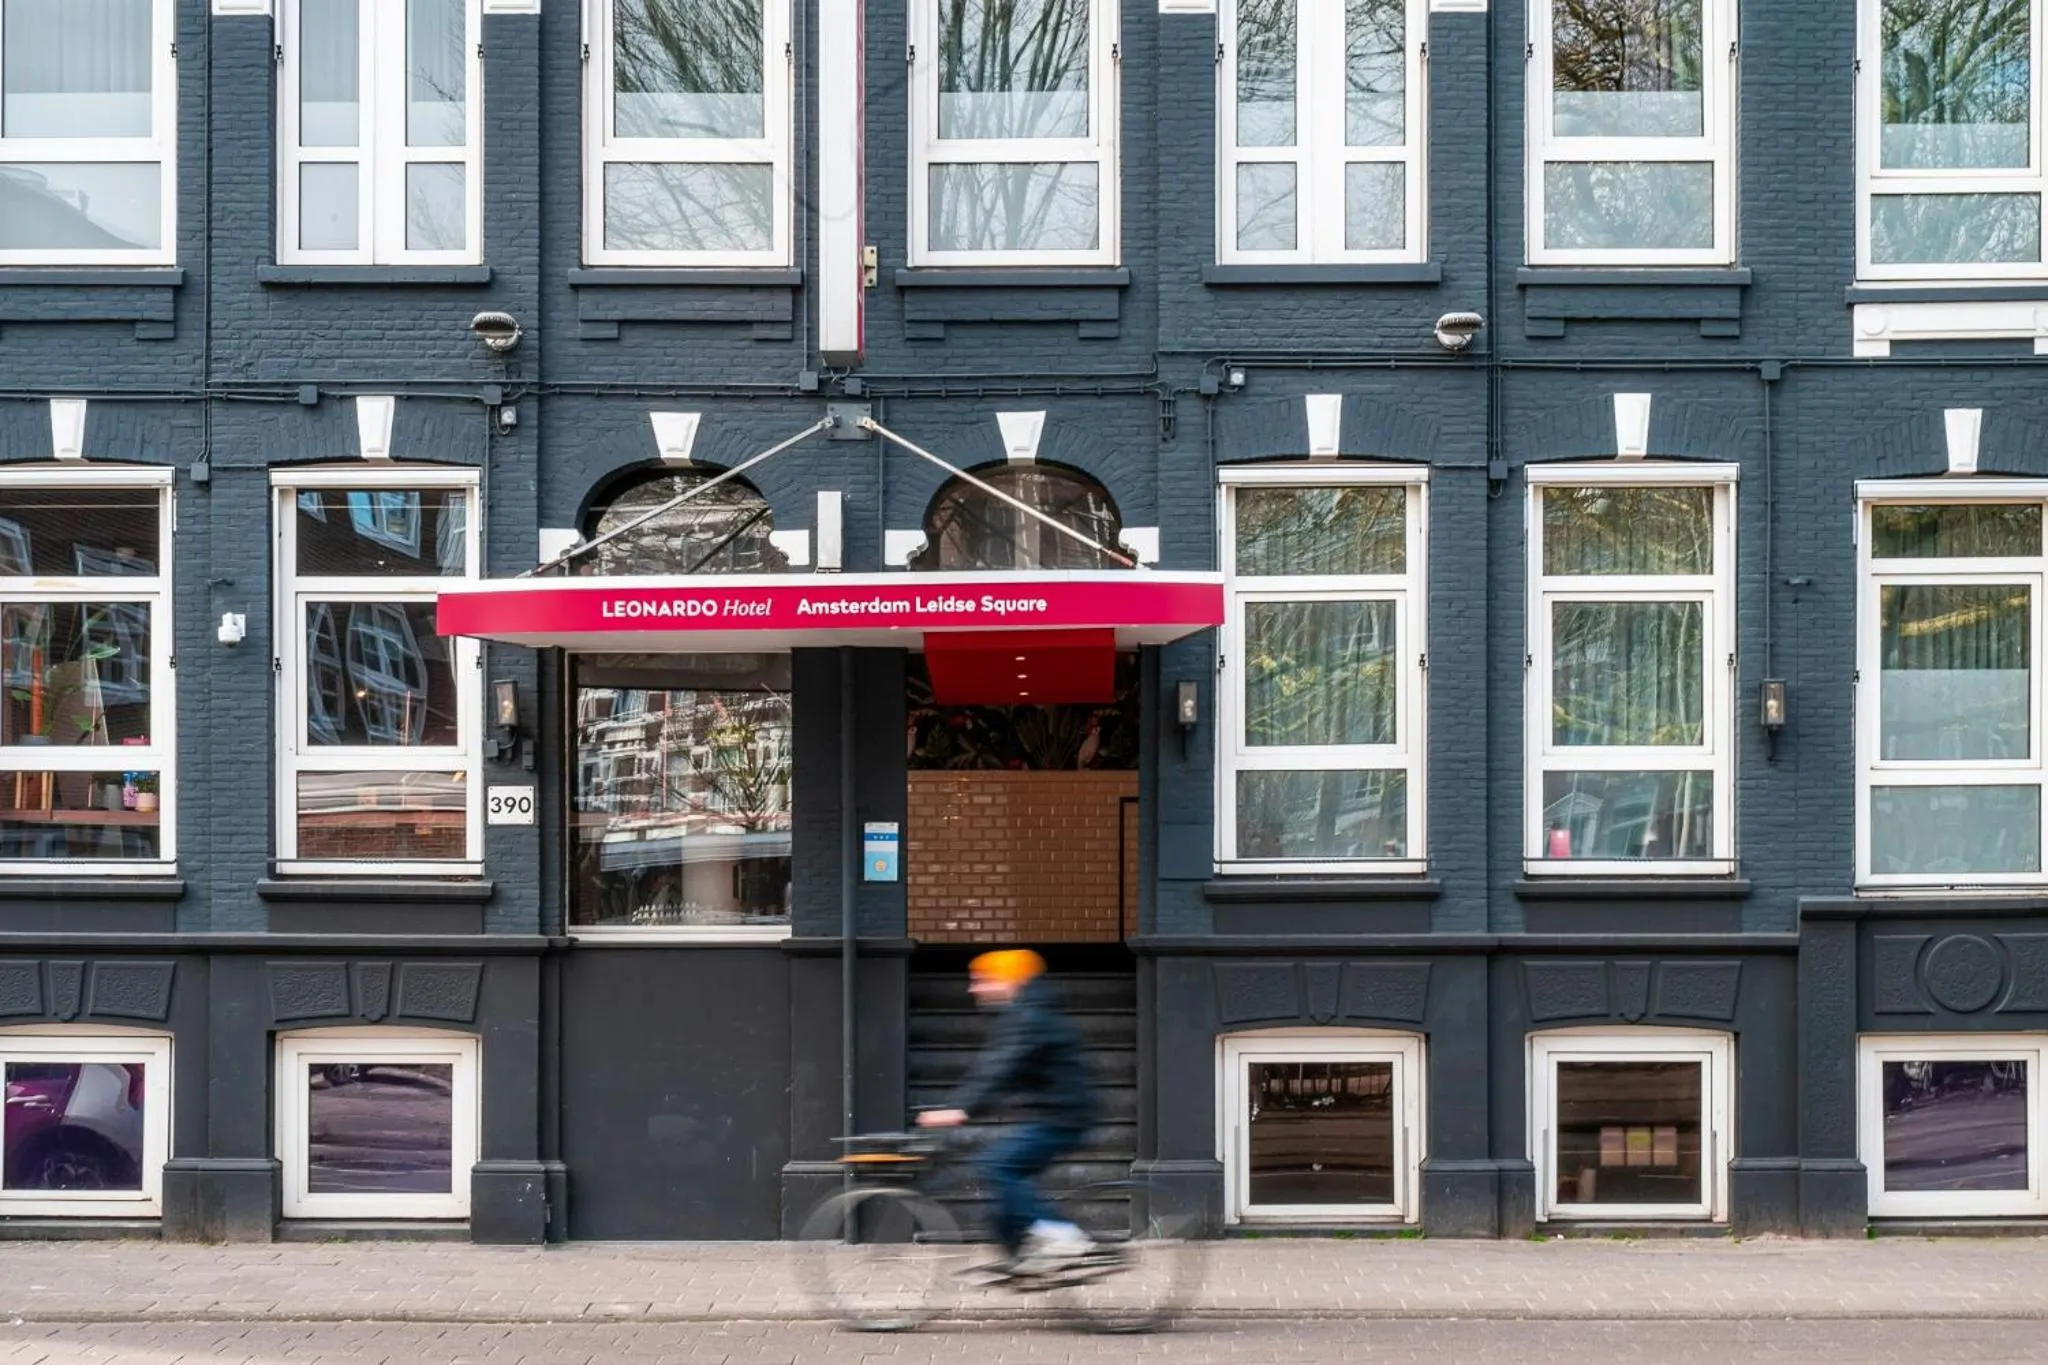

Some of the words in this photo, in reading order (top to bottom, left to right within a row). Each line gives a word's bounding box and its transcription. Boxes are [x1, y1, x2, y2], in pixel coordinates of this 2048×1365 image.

[602, 600, 718, 617] LEONARDO
[722, 598, 772, 616] Hotel
[797, 598, 911, 615] Amsterdam
[916, 596, 976, 613] Leidse
[980, 595, 1048, 616] Square
[490, 797, 532, 813] 390
